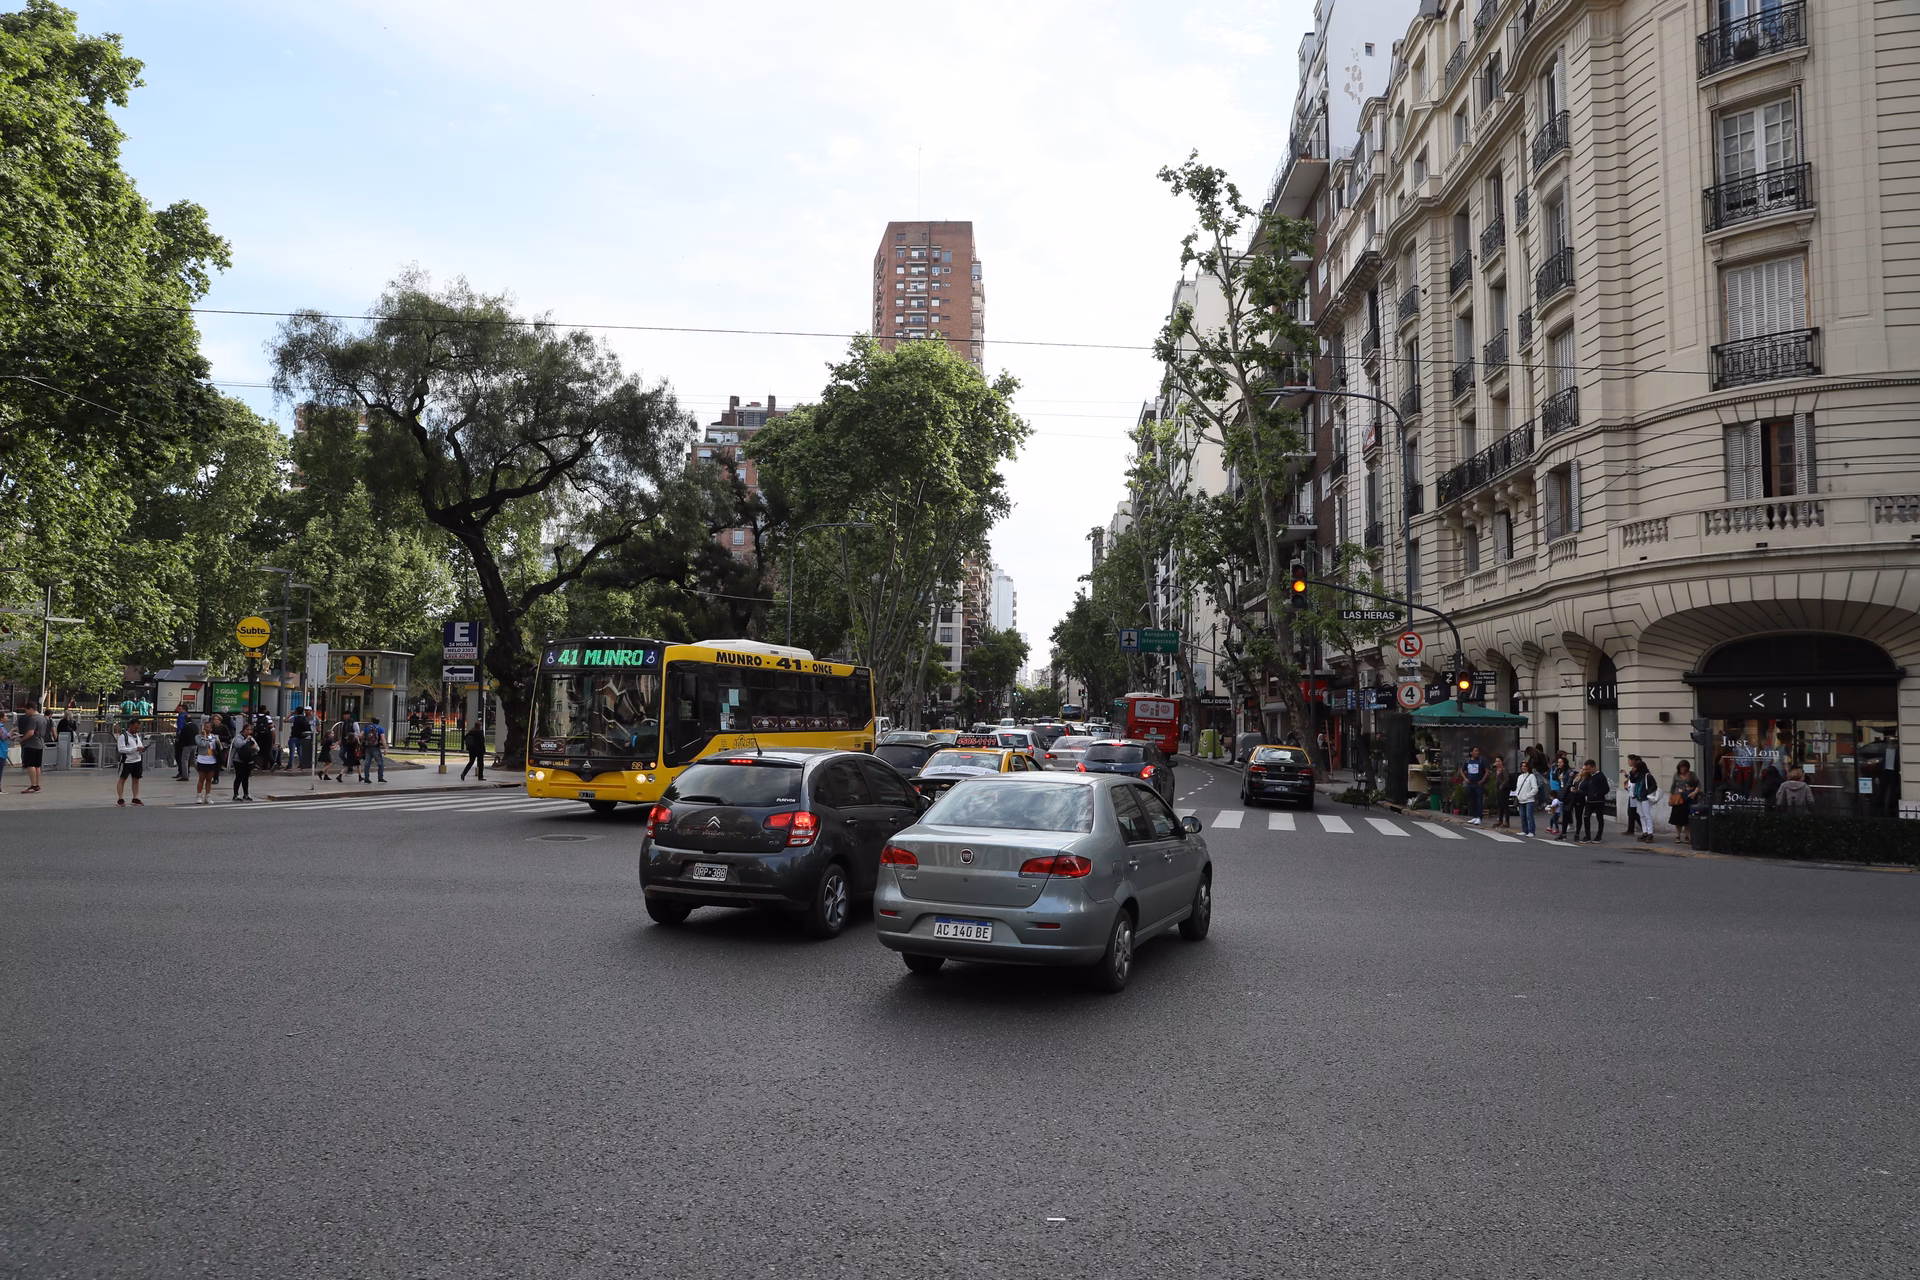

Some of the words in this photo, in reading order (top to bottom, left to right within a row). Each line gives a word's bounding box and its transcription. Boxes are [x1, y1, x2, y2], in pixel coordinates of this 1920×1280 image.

[1343, 611, 1361, 619] LAS
[1364, 611, 1395, 620] HERAS
[239, 626, 267, 634] Subte
[455, 622, 469, 642] E
[558, 650, 578, 665] 41
[584, 649, 644, 666] MUNRO
[716, 651, 762, 666] MUNRO
[776, 658, 802, 670] 41
[812, 664, 833, 674] ONCE
[1405, 686, 1416, 700] 4
[1604, 728, 1616, 738] Just
[1720, 735, 1748, 747] Just
[1745, 747, 1780, 757] Mom
[936, 924, 949, 936] AC
[952, 924, 973, 938] 140
[975, 926, 990, 939] BE
